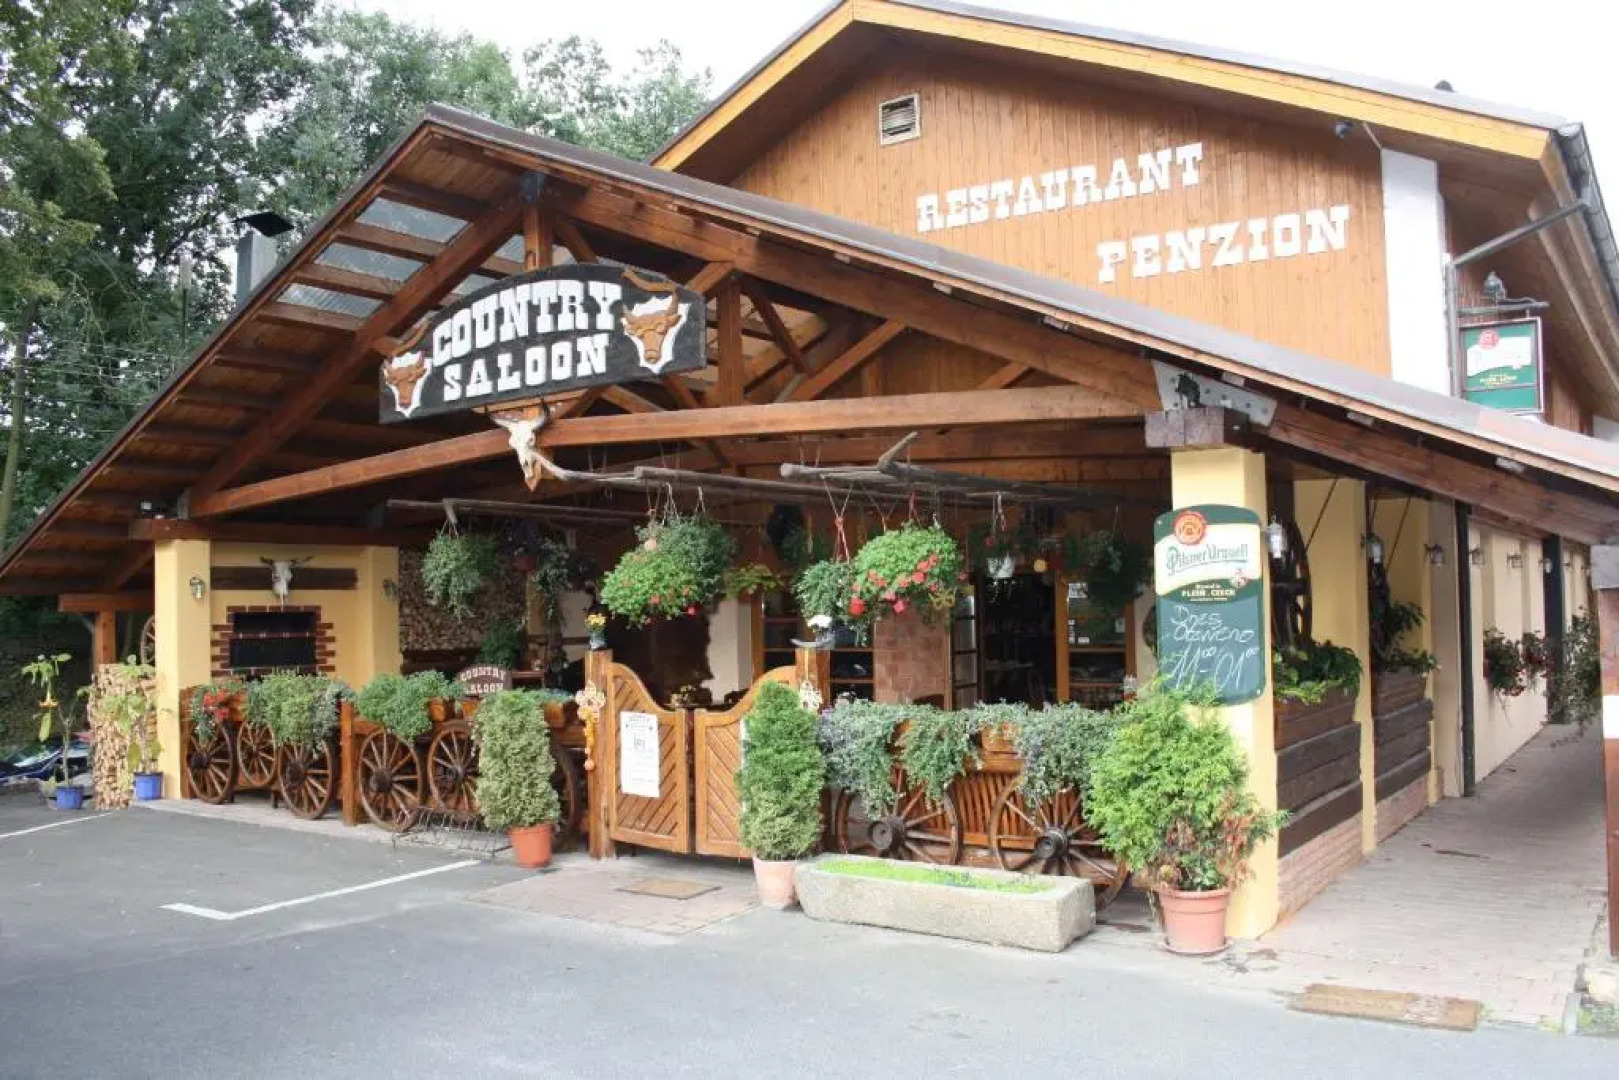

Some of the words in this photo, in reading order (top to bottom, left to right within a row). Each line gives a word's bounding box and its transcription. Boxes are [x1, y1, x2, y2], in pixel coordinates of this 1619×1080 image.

[917, 142, 1202, 232] RESTAURANT
[1097, 204, 1350, 283] PENZION
[432, 279, 622, 367] COUNTRY
[443, 333, 610, 402] SALOON
[461, 666, 506, 682] COUNTRY
[466, 682, 504, 694] ALOON
